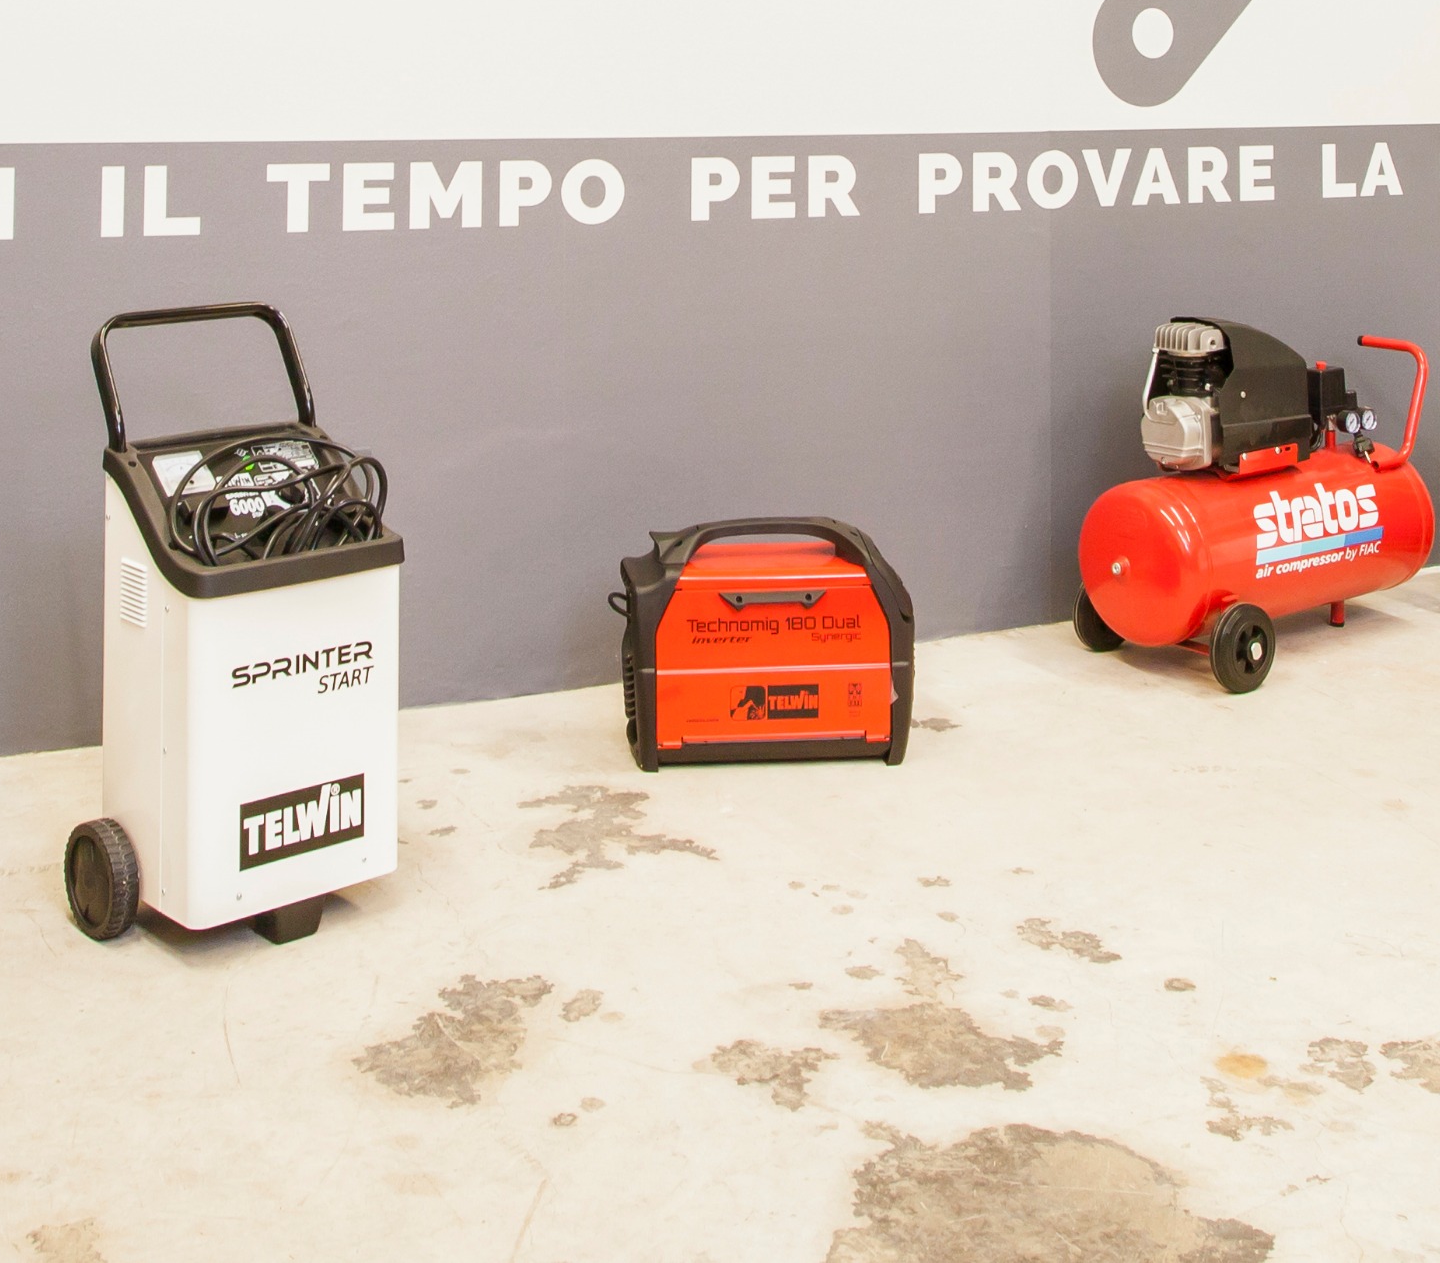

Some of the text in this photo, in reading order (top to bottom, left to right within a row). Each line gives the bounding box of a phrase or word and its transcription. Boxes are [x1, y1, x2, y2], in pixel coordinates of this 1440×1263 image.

[100, 165, 202, 238] IL
[266, 158, 626, 233] TEMPO
[690, 155, 861, 222] PER
[917, 145, 1276, 214] PROVARE
[1321, 142, 1404, 199] LA
[229, 497, 265, 516] 6000
[1253, 482, 1379, 550] stratos
[1255, 541, 1382, 580] air compressor by FIAC
[686, 614, 862, 635] Technomig 180 Dual
[691, 632, 862, 645] inverter Synergic
[231, 640, 374, 689] SPRINTER
[317, 665, 375, 694] START
[768, 691, 819, 711] TELWIN
[243, 783, 363, 857] TELWIN
